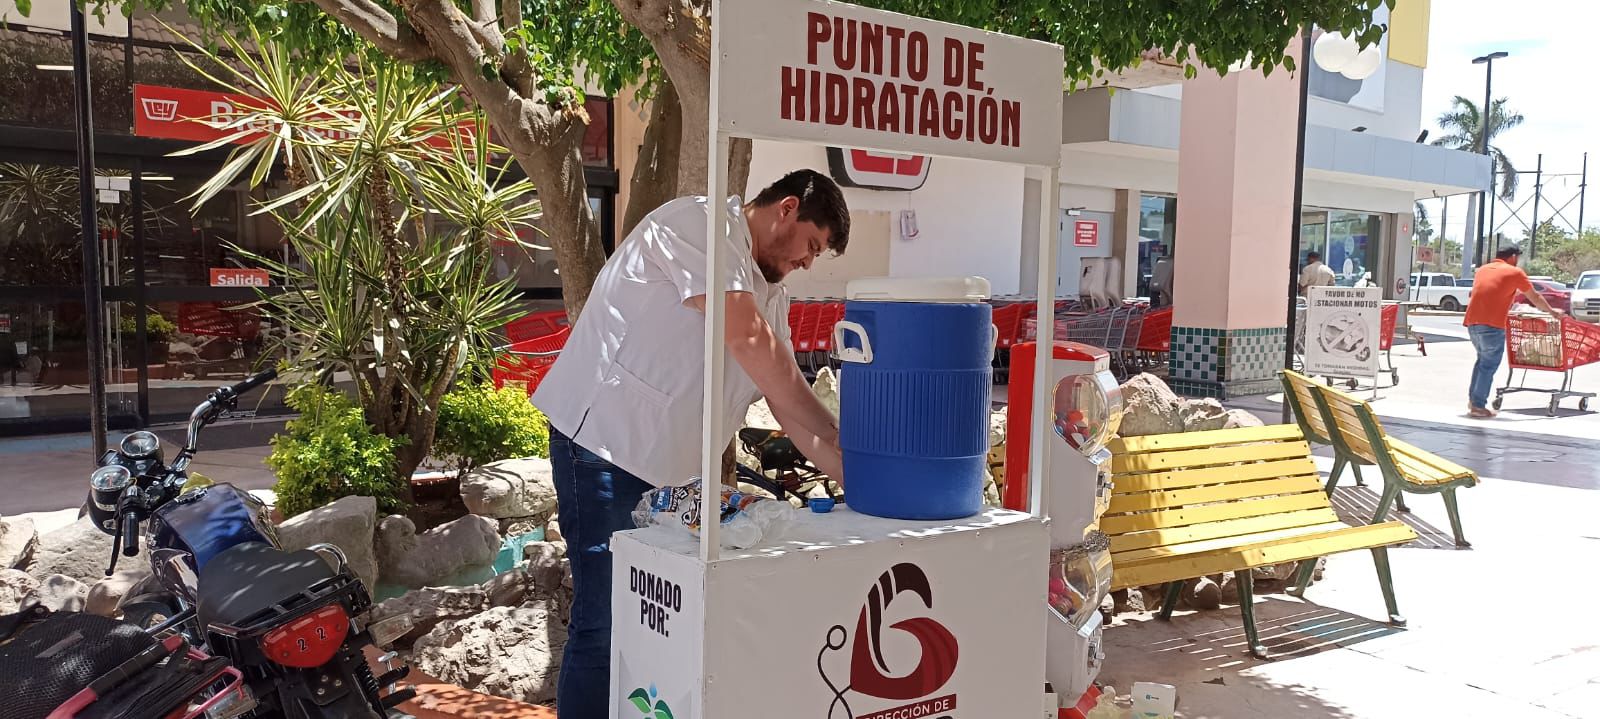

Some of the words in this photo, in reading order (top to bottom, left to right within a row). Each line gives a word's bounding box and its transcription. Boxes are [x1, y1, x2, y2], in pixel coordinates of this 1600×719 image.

[807, 12, 929, 82] PUNTO
[943, 37, 985, 91] DE
[780, 66, 1021, 147] HIDRATACIÓN
[217, 274, 263, 285] Salida
[1315, 299, 1353, 308] STACIONAR
[1354, 300, 1378, 308] MOTOS
[1325, 290, 1345, 298] FAVOR
[630, 565, 682, 613] DONADO
[640, 598, 670, 637] POR:
[297, 638, 308, 652] 2
[317, 628, 328, 640] 2
[865, 703, 930, 719] ECCIÓN
[934, 699, 950, 711] DE
